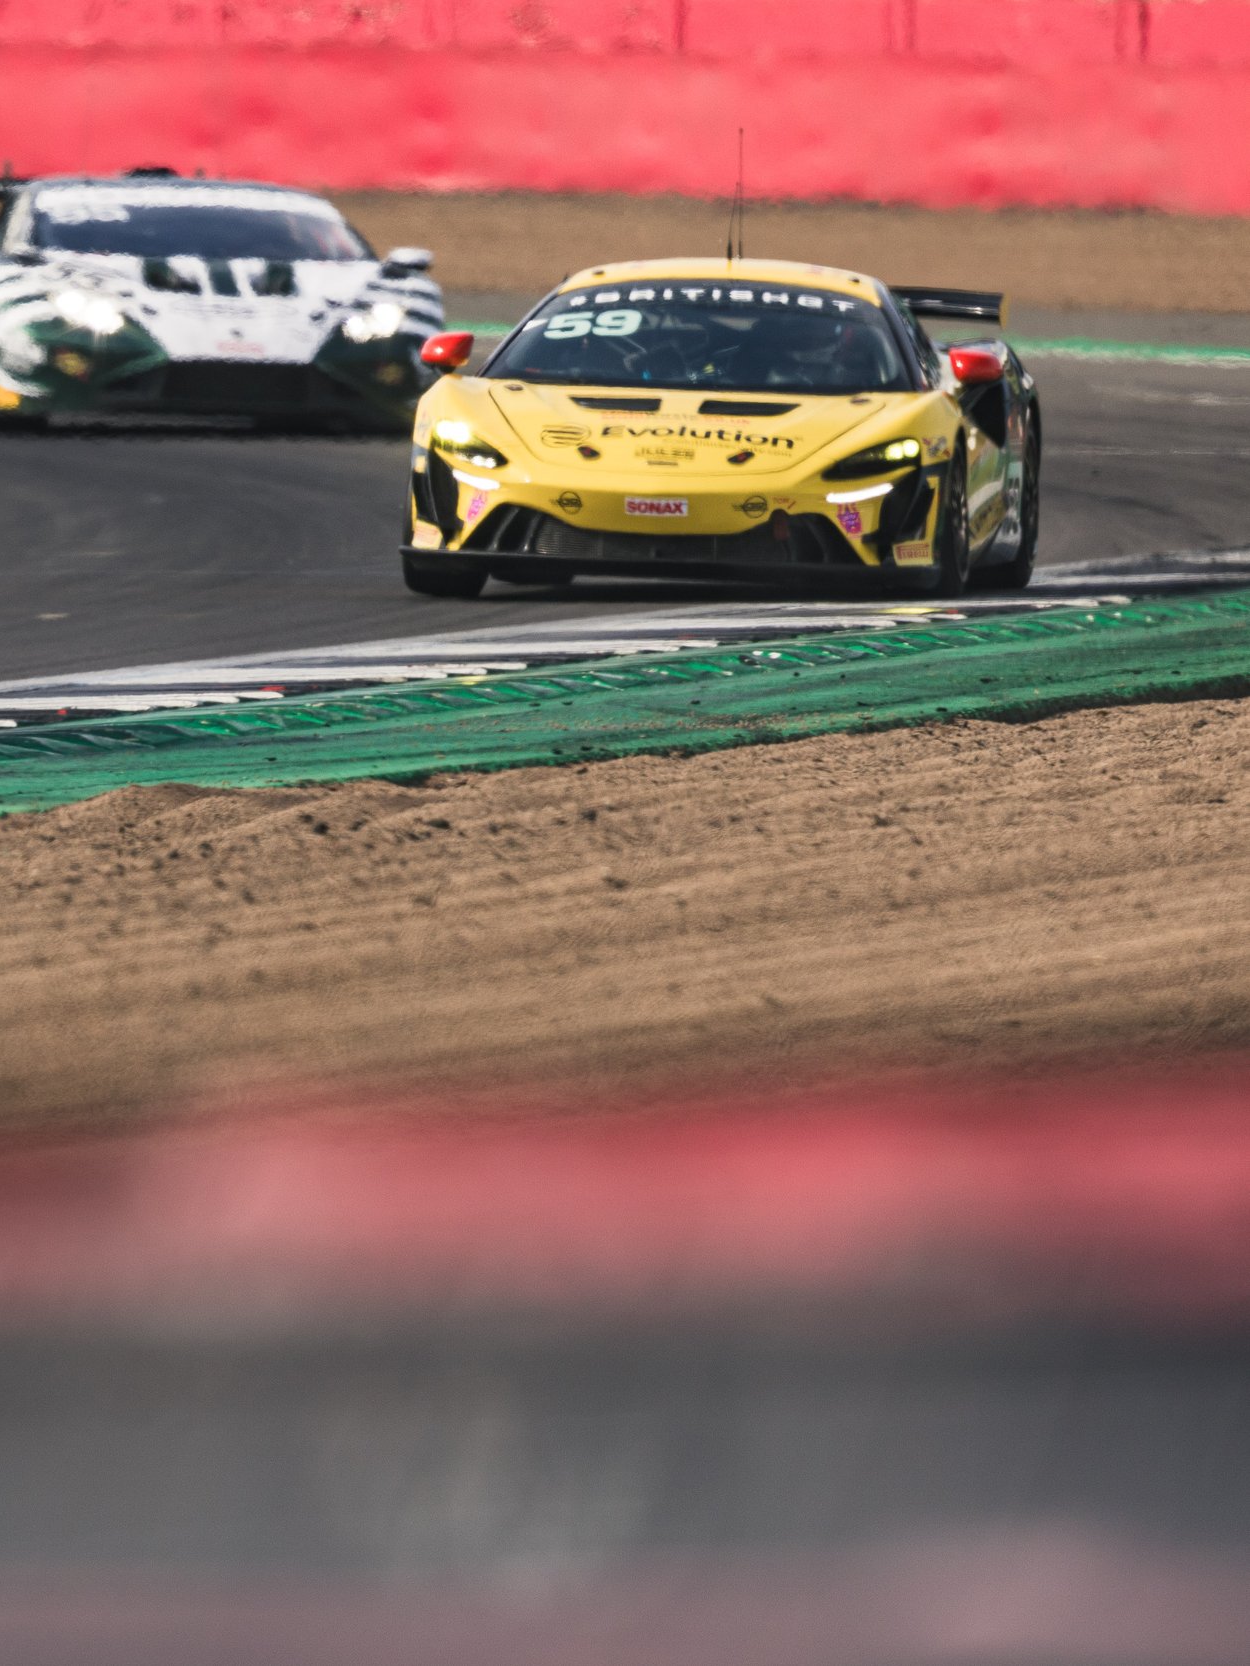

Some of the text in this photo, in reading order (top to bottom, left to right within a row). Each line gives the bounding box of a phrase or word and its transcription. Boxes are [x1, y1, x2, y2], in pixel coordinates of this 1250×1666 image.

[543, 308, 643, 340] 59
[601, 425, 795, 449] Evolution
[626, 500, 684, 514] SONAX
